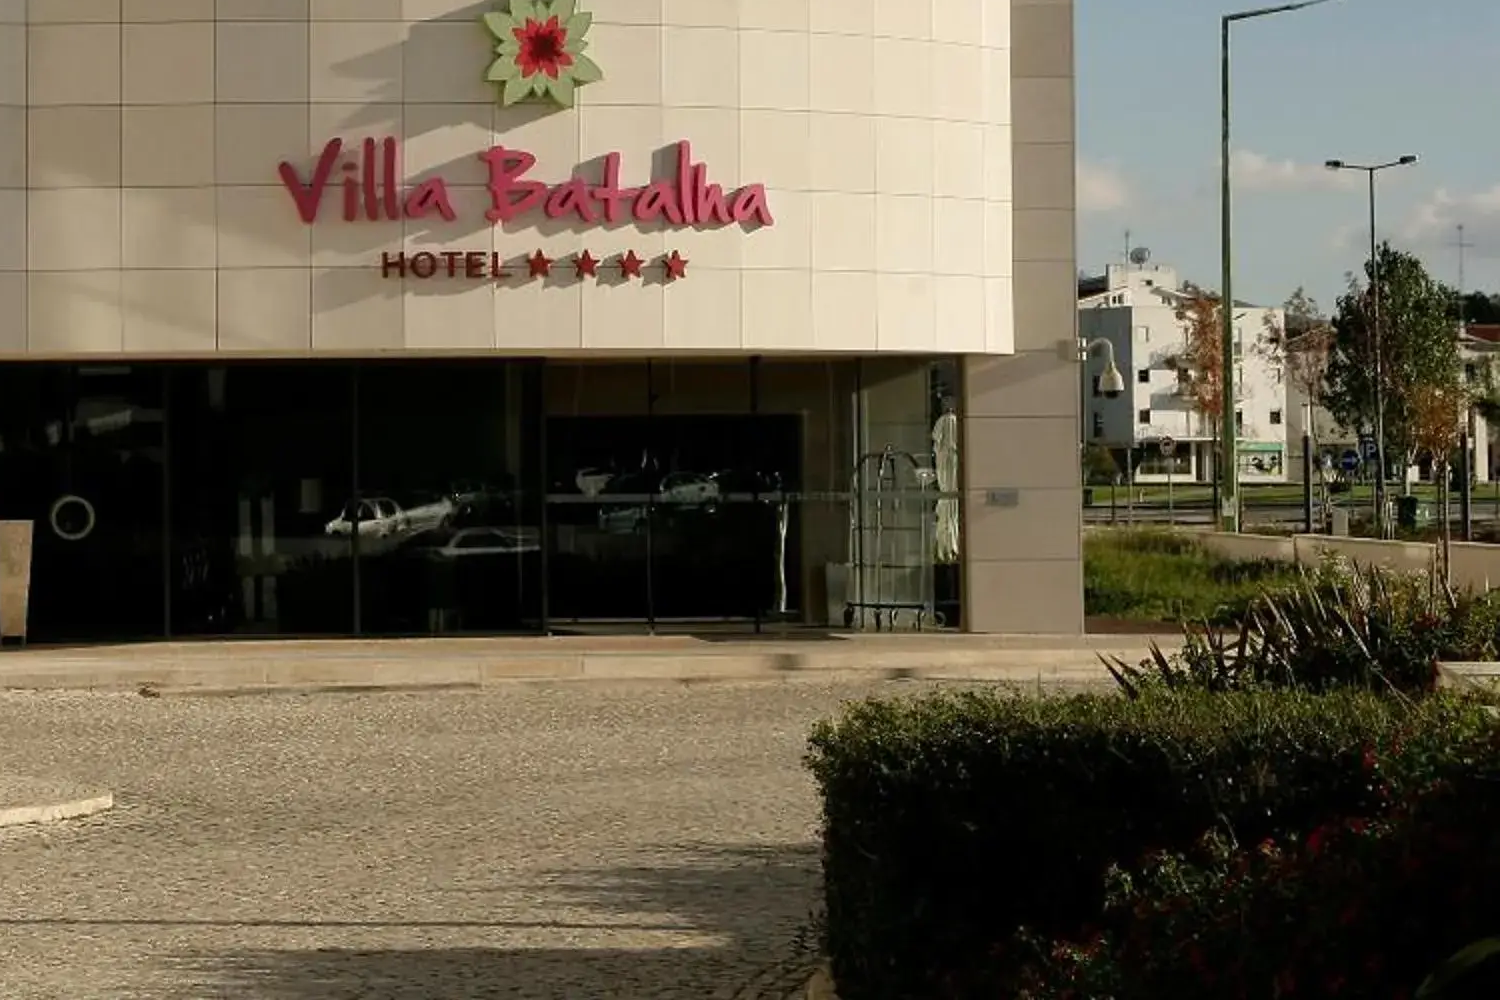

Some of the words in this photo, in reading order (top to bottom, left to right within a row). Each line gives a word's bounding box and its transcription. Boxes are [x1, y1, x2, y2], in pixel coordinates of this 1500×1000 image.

[278, 136, 457, 224] Villa
[478, 139, 774, 226] Batalha
[381, 251, 512, 279] HOTEL
[1365, 443, 1377, 458] P
